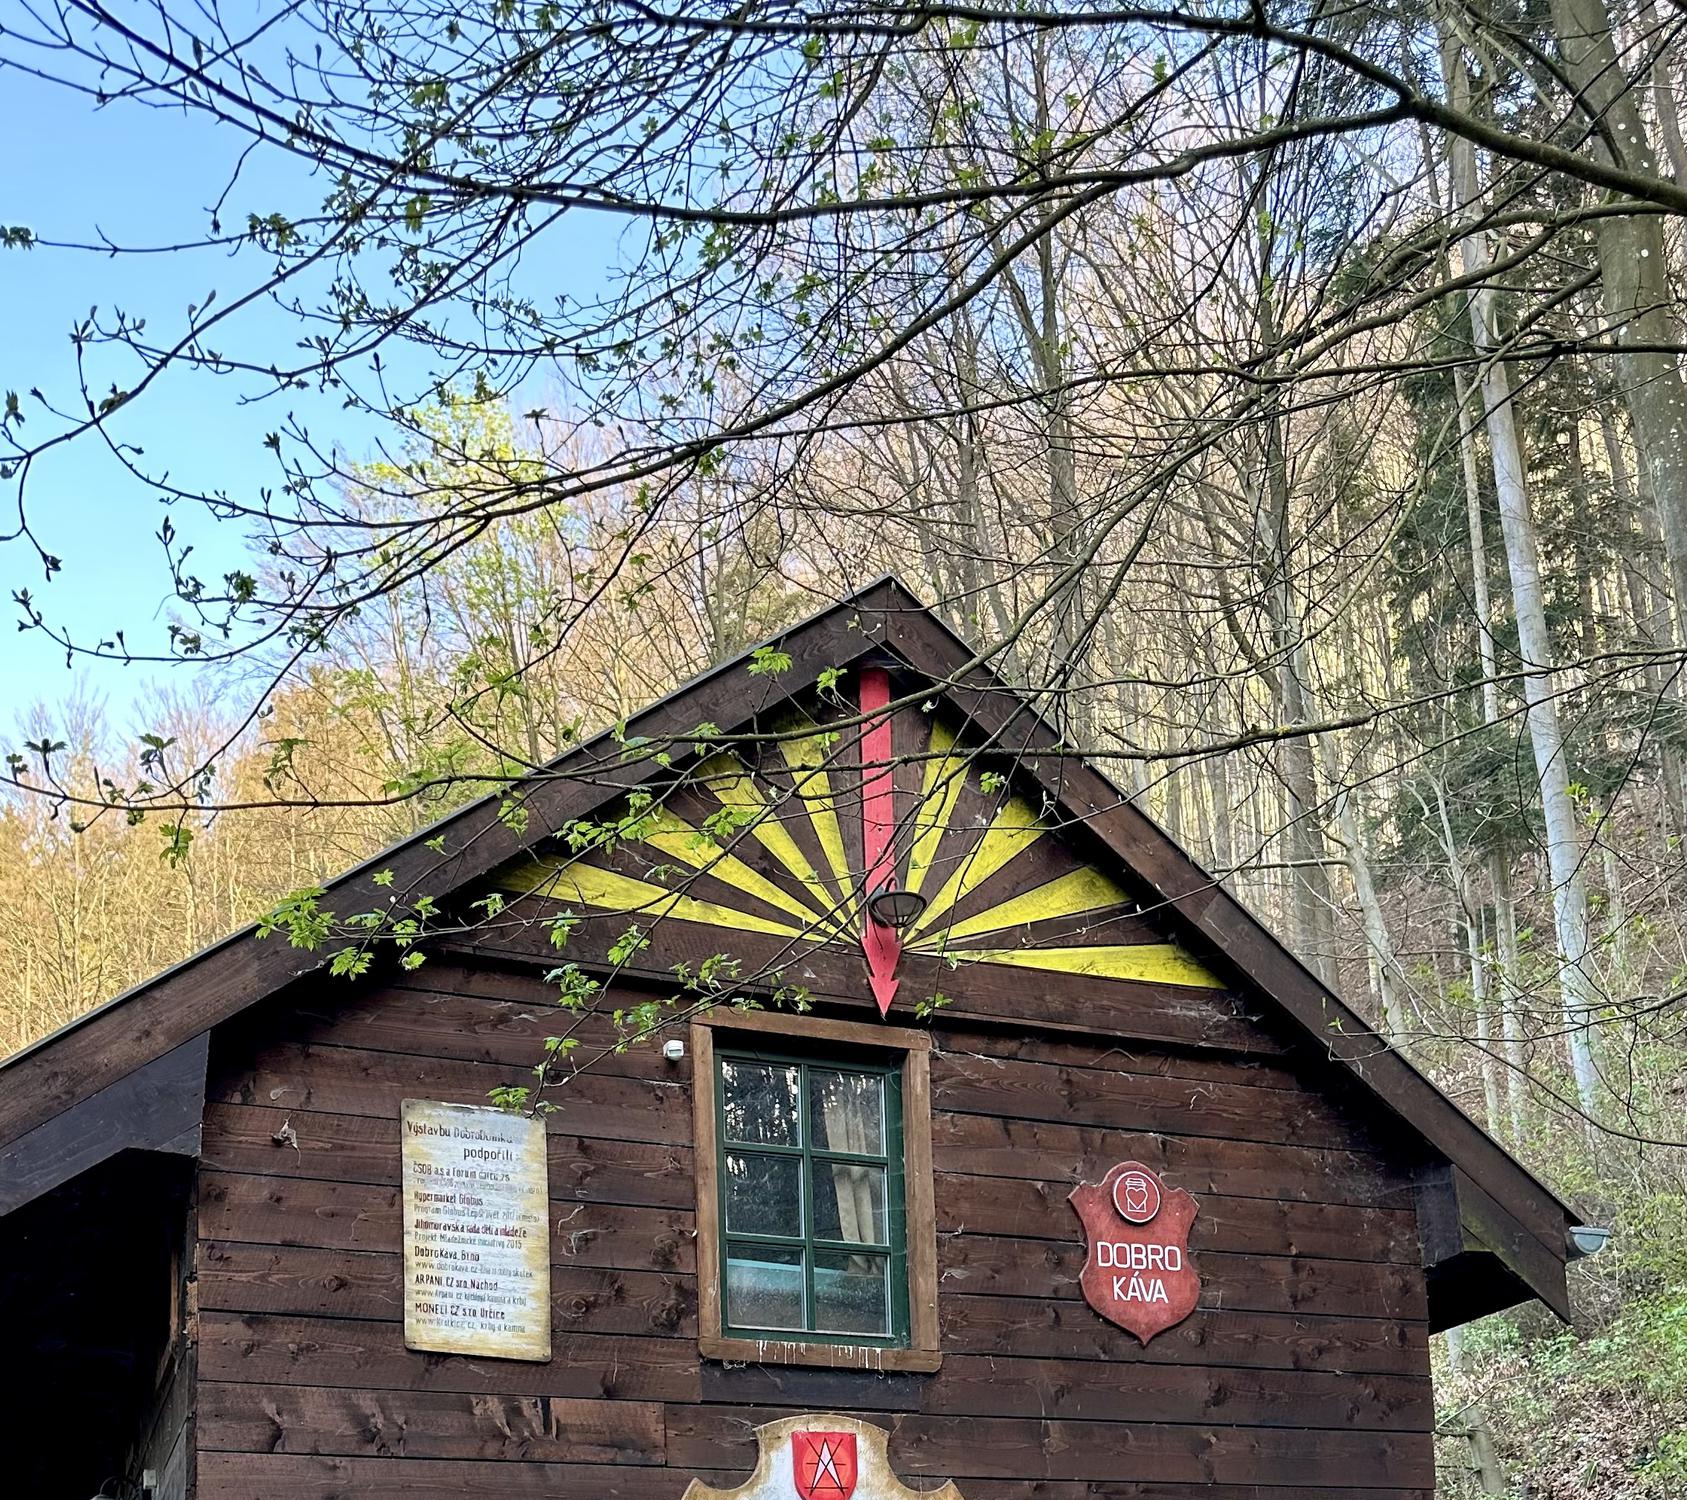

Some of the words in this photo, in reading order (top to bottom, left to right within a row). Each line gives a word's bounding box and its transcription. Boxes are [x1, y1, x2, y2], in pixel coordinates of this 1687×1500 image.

[407, 1120, 451, 1136] Výstavbu
[413, 1160, 432, 1176] ČSOB
[414, 1190, 457, 1204] Hypermarket
[459, 1193, 484, 1206] Globus
[414, 1203, 442, 1216] Program
[443, 1204, 466, 1217] Globus
[414, 1231, 437, 1243] Projekt
[461, 1249, 480, 1262] Brno
[1097, 1241, 1182, 1271] DOBRO
[415, 1274, 443, 1287] ARPANI
[446, 1276, 455, 1288] CZ
[1113, 1271, 1169, 1304] KÁVA
[450, 1304, 460, 1317] CZ
